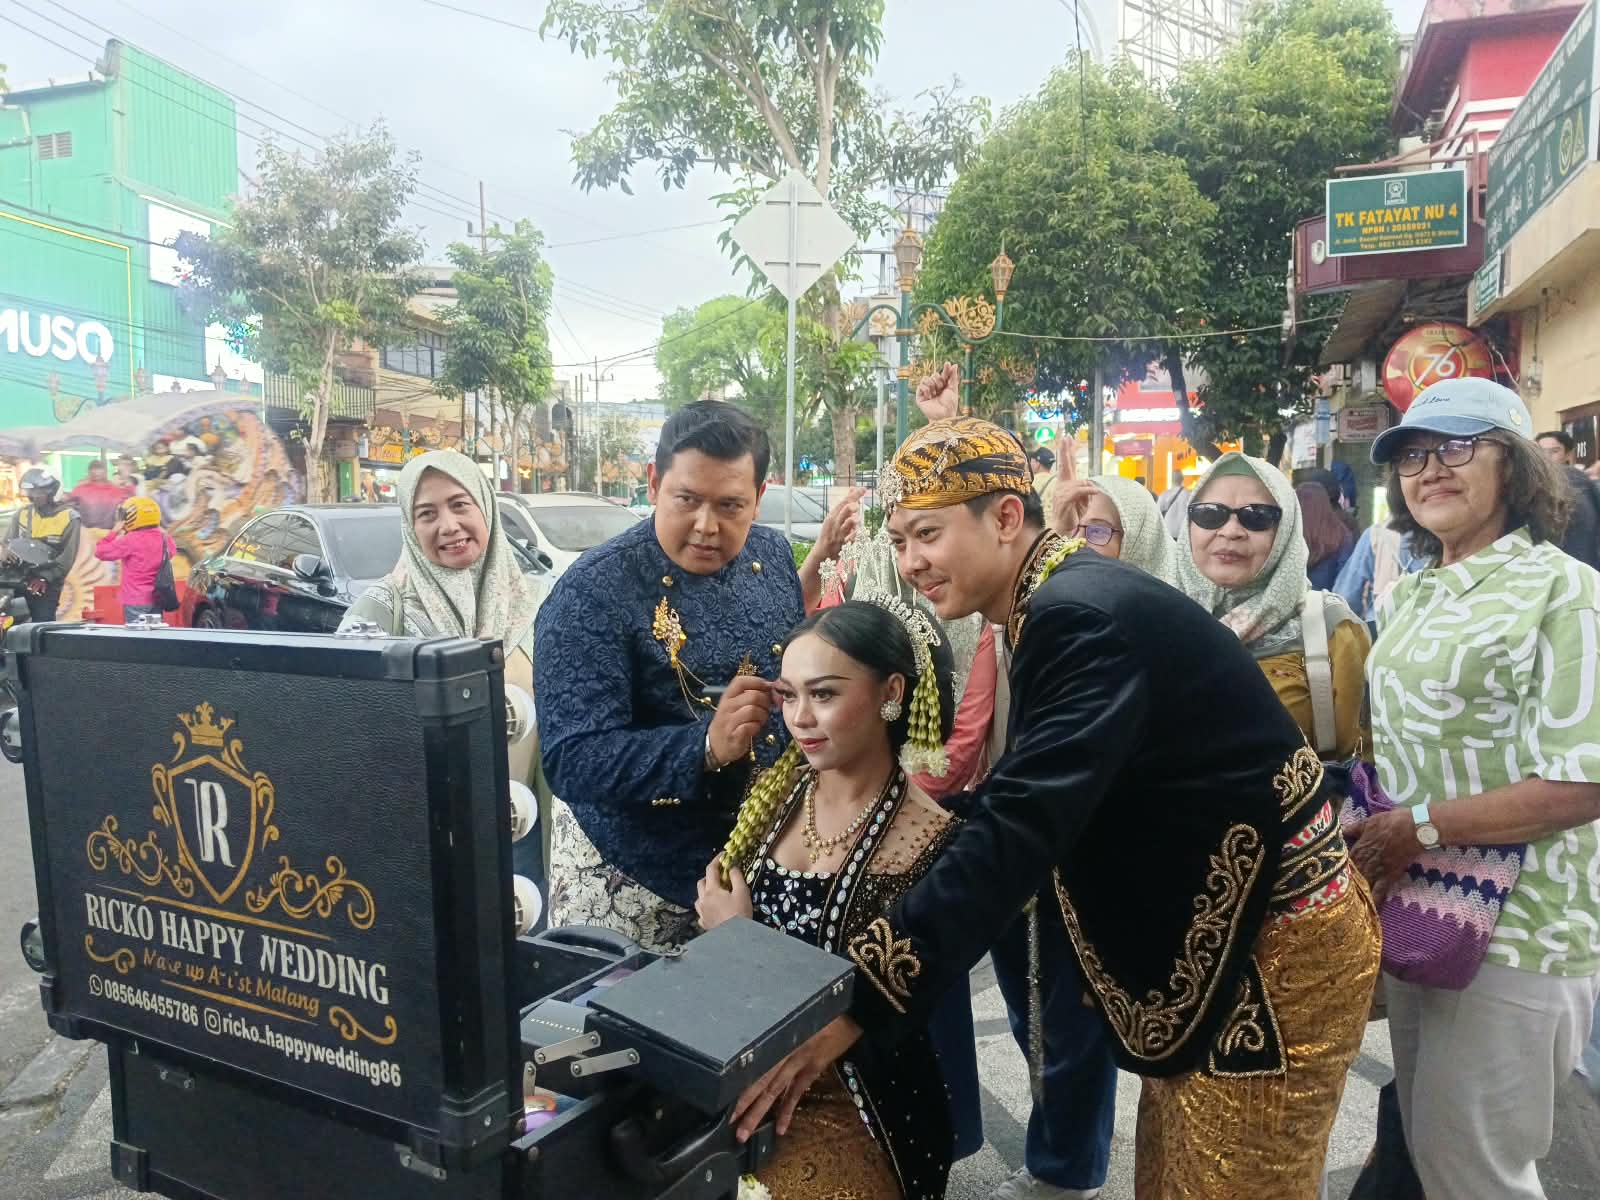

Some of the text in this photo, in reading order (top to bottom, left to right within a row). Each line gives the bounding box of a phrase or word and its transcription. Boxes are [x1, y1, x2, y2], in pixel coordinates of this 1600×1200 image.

[1335, 203, 1458, 228] TK FATAYAT NU 4
[1414, 346, 1457, 386] 76
[85, 892, 389, 1005] RICKO HAPPY WEDDING
[143, 947, 182, 975] Mae
[208, 964, 253, 994] Atst
[255, 977, 321, 1018] Malang
[104, 979, 401, 1088] 085646455786 ricko_happywedding86
